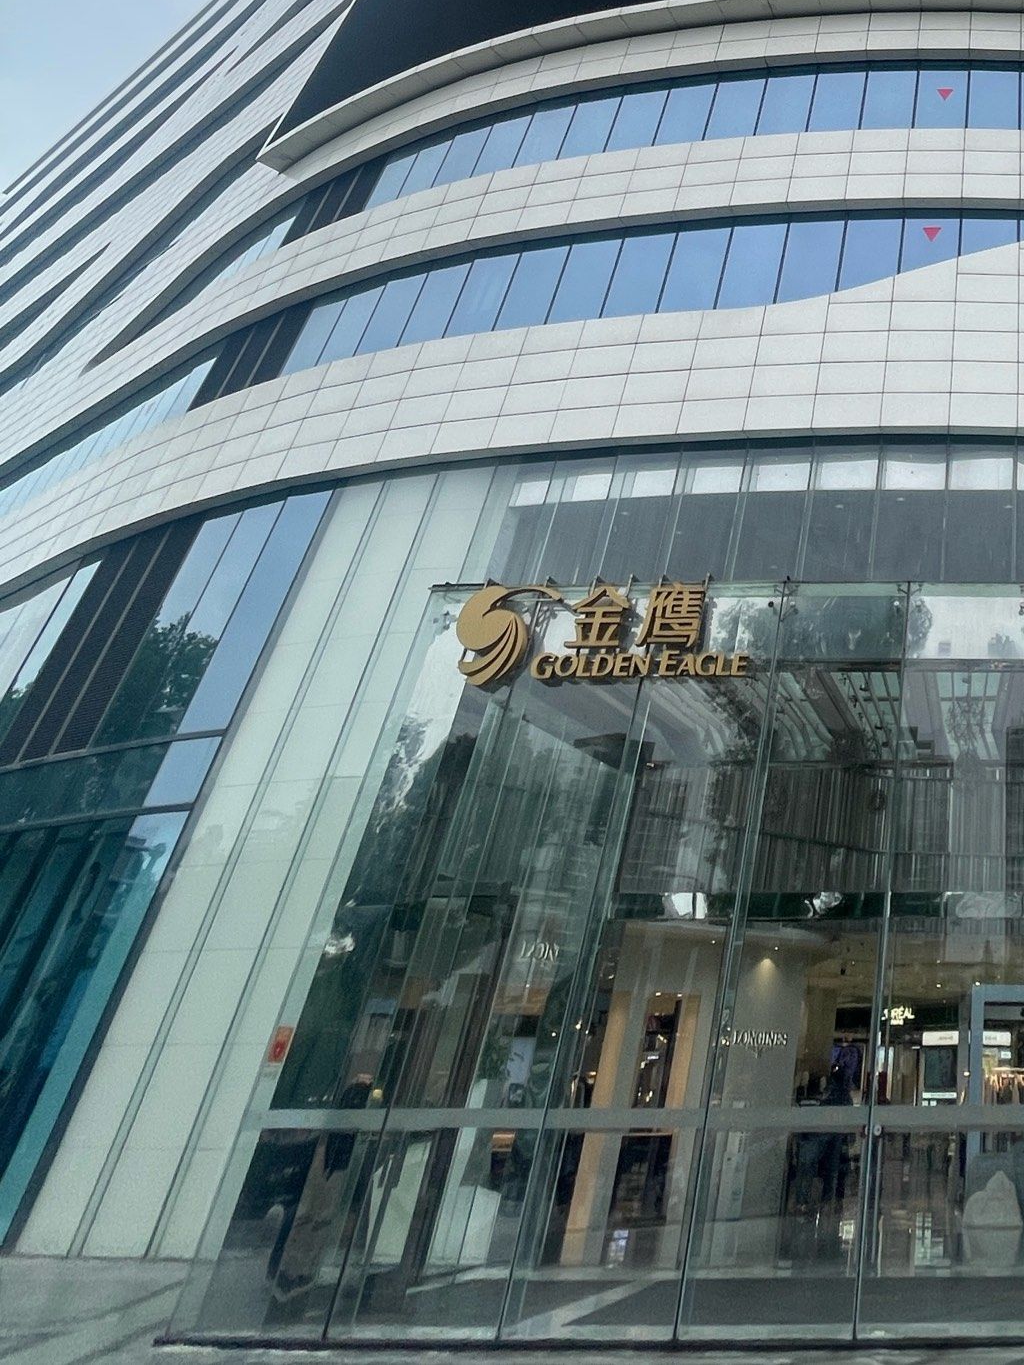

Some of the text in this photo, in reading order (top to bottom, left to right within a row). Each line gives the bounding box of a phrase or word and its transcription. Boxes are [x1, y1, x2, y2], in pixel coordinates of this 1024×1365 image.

[563, 582, 706, 648] 金鹰
[531, 649, 749, 680] GOLDEN EAGLE
